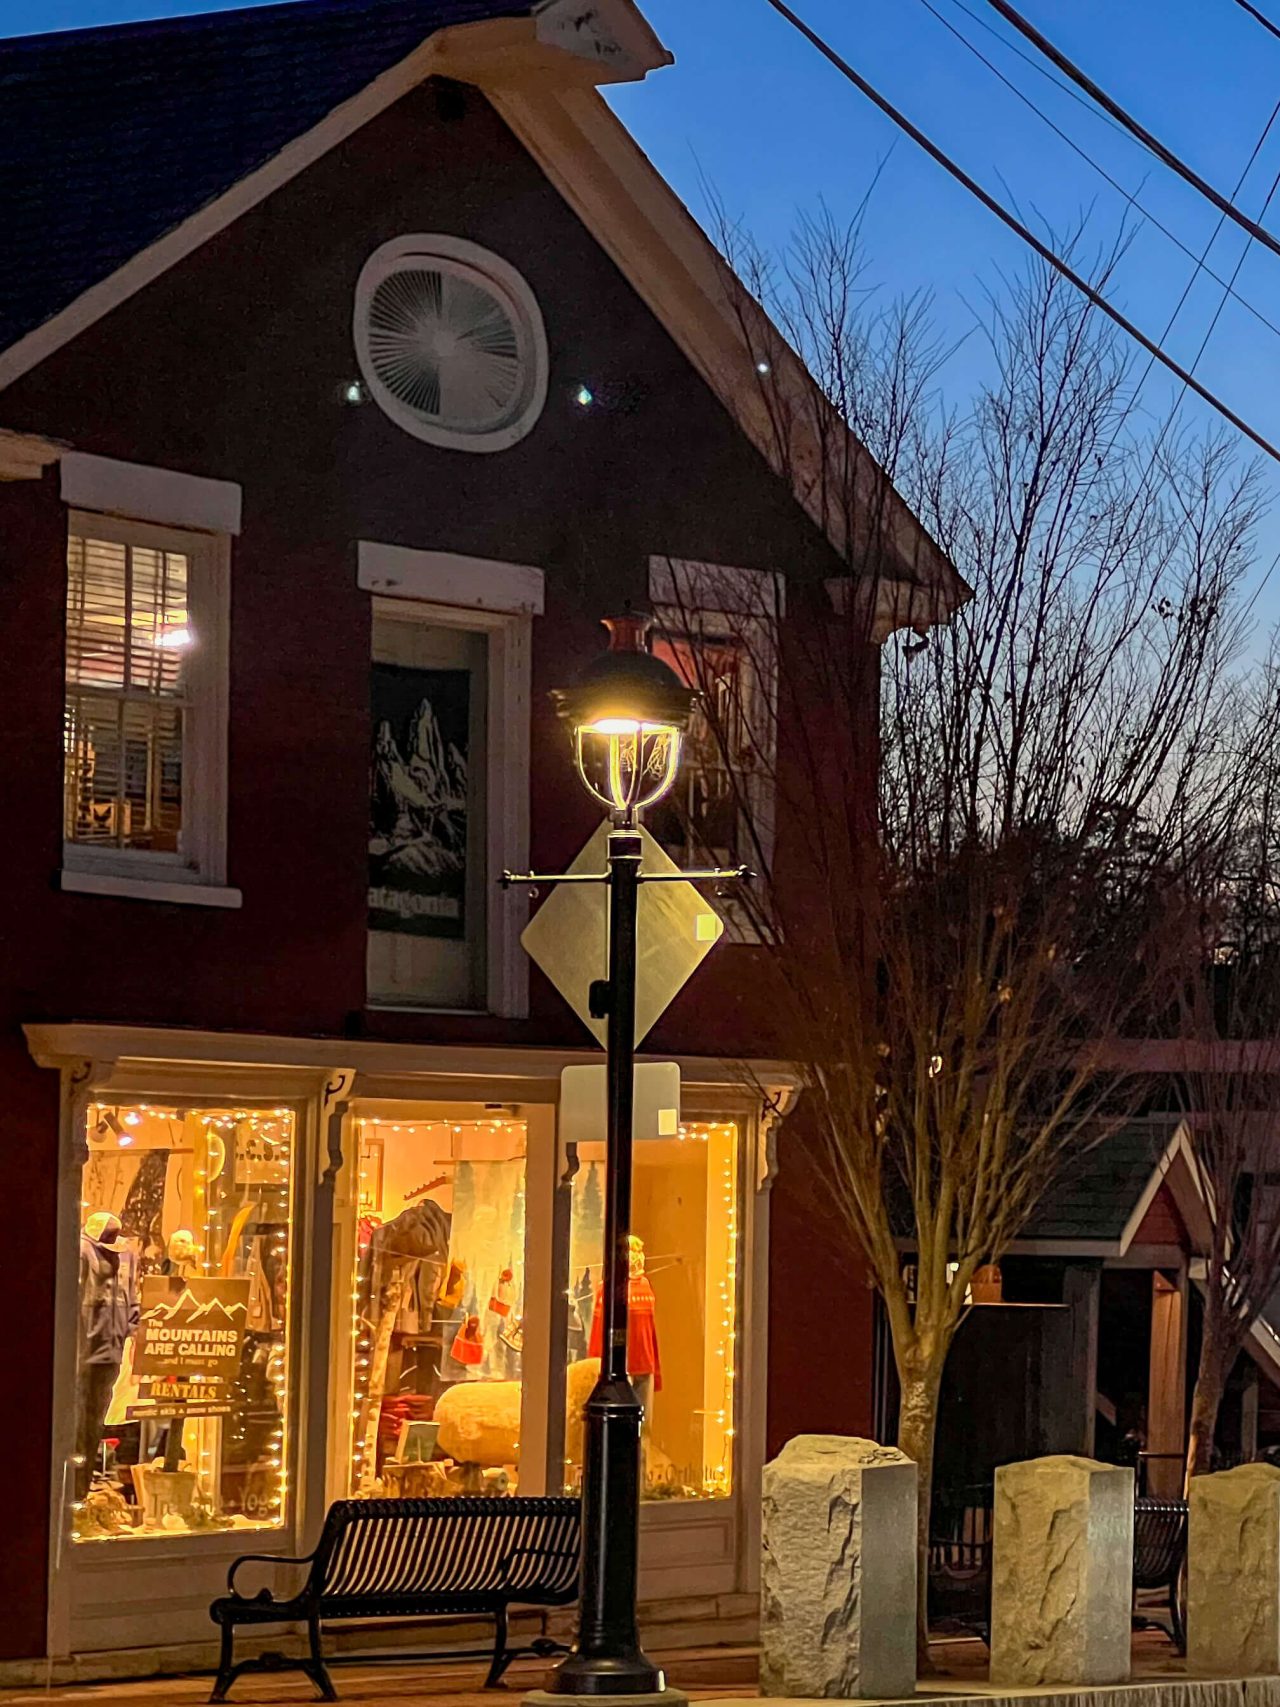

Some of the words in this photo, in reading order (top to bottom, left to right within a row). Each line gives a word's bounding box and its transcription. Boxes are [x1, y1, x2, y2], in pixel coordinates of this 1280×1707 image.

[367, 886, 459, 918] atagonia
[148, 1319, 163, 1328] The
[146, 1328, 238, 1343] MOUNTAINS
[144, 1343, 175, 1355] ARE
[178, 1343, 236, 1357] CALLING
[207, 1358, 218, 1368] go
[150, 1381, 217, 1399] RENTALS
